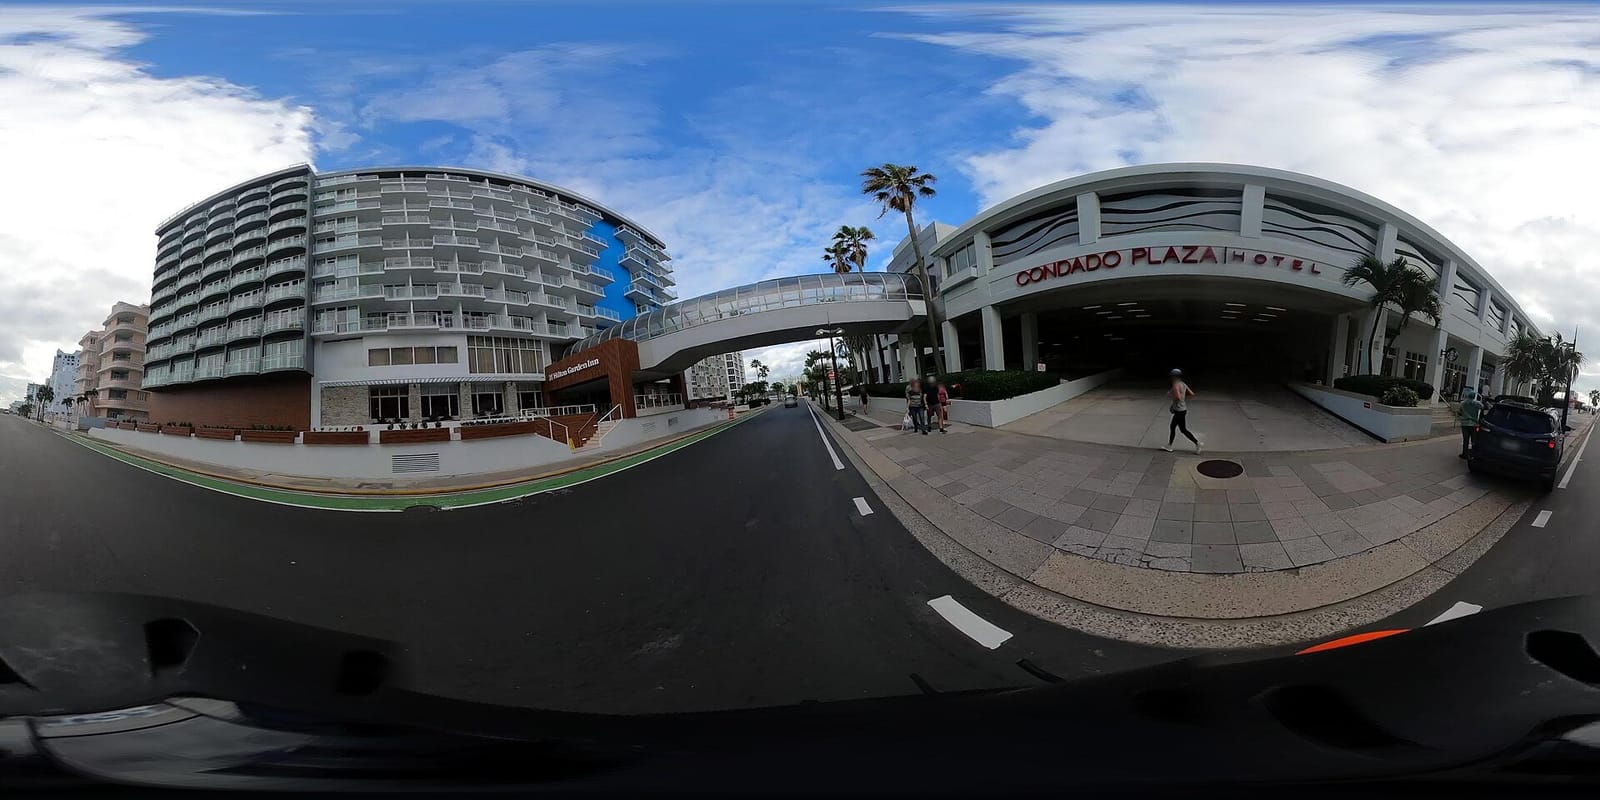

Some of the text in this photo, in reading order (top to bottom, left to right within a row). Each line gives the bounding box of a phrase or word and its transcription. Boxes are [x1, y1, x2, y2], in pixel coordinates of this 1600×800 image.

[1016, 246, 1322, 287] CONDADO PLAZA HOTEL
[553, 358, 599, 380] Hilton Garden Inn
